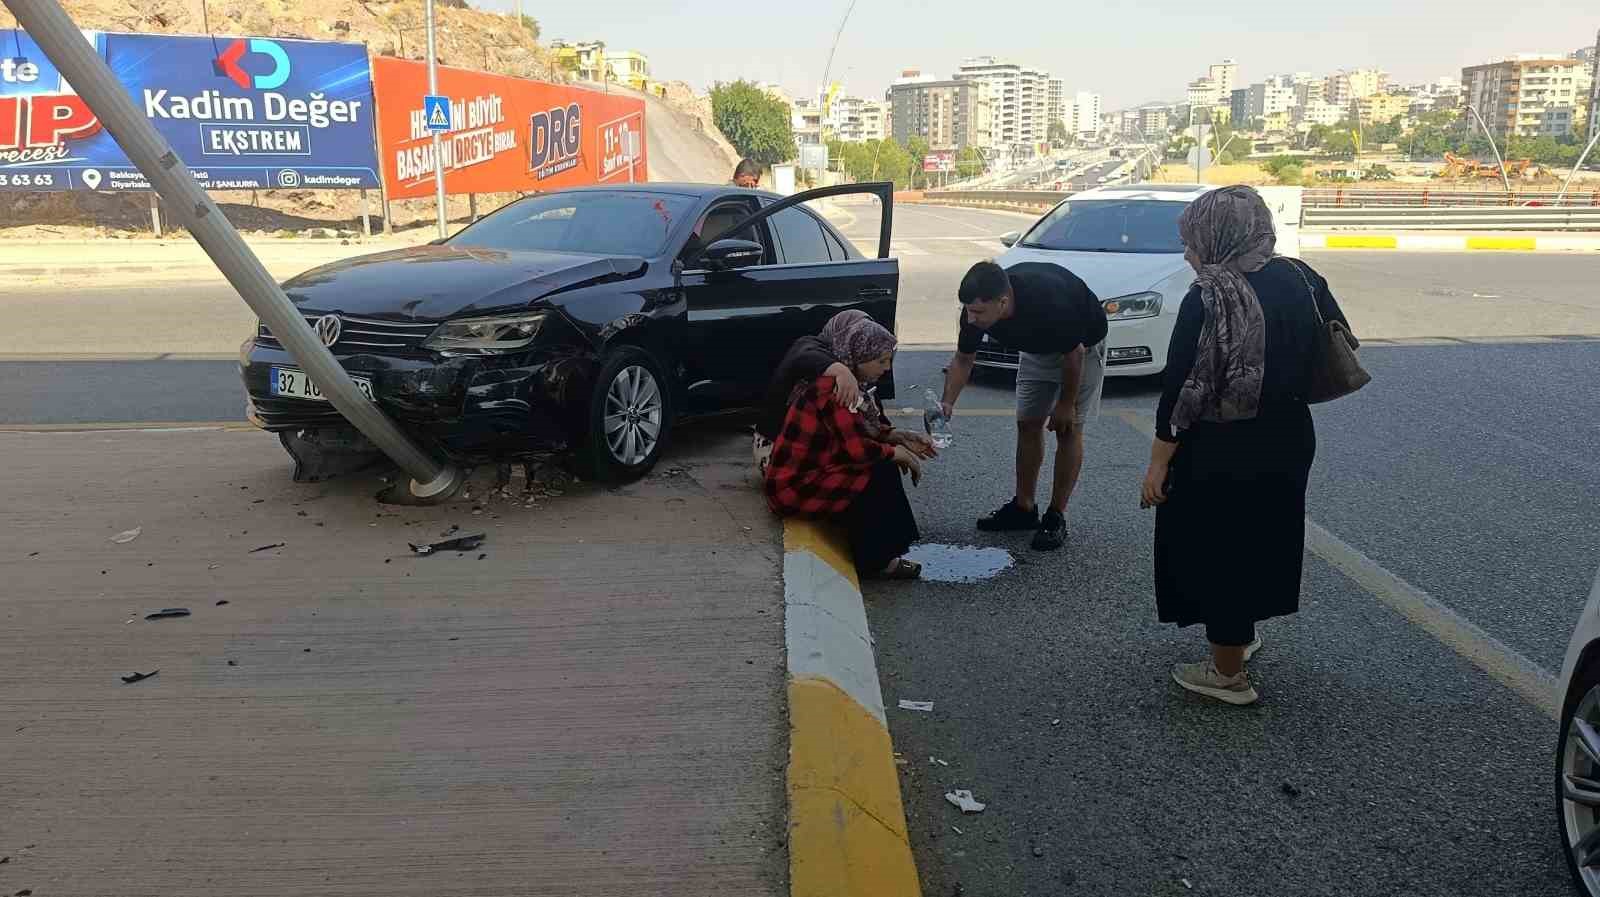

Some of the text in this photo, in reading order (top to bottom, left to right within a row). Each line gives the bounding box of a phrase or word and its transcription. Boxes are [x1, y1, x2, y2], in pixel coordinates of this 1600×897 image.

[143, 89, 361, 128] Kadim Değer
[211, 130, 301, 155] EKSTREM
[530, 102, 580, 171] DRG
[11, 174, 31, 186] 63
[34, 174, 54, 186] 63
[304, 175, 361, 186] kadimdeger
[279, 373, 294, 393] 32
